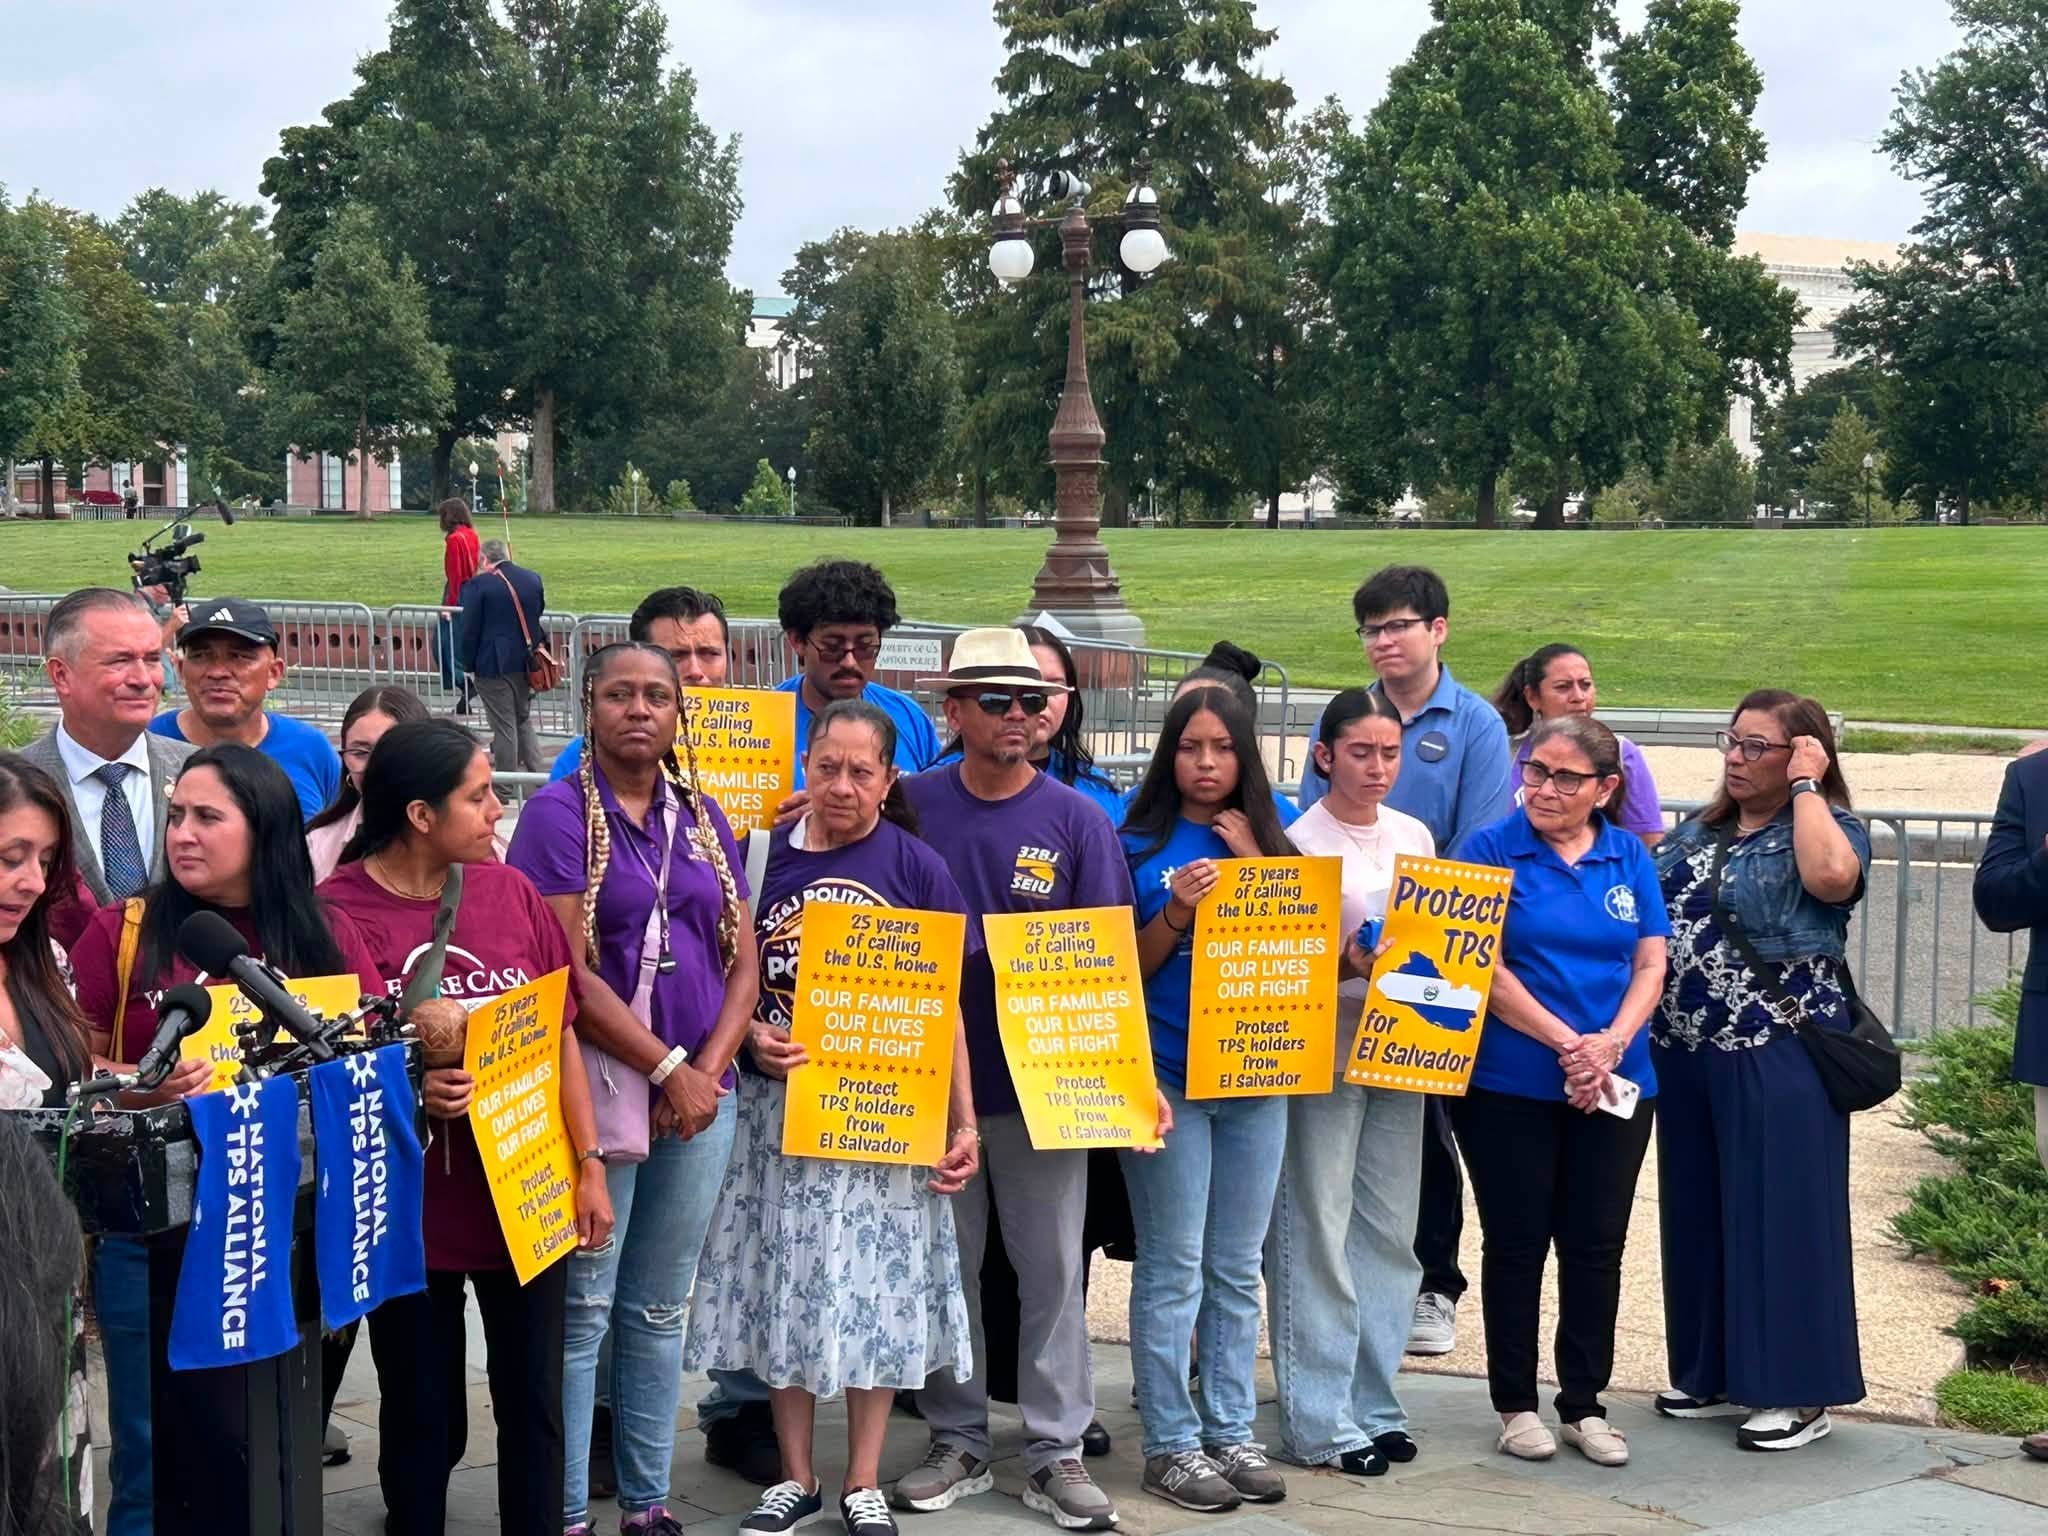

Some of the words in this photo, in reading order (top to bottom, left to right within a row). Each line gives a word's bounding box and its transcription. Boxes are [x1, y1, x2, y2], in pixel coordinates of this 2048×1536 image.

[684, 697, 702, 710] 25
[708, 699, 750, 713] years
[702, 715, 753, 733] calling
[693, 732, 722, 748] U.S.
[729, 734, 771, 749] home
[699, 771, 780, 791] FAMILIES
[1010, 877, 1054, 894] SEIU
[1239, 867, 1256, 882] 25
[1260, 866, 1300, 884] years
[1234, 884, 1252, 900] of
[1254, 883, 1302, 901] calling
[1393, 875, 1505, 925] Protect
[1217, 903, 1240, 918] the
[1245, 902, 1273, 917] U.S.
[1278, 902, 1318, 915] home
[851, 914, 871, 930] 25
[876, 917, 920, 940] years
[1025, 921, 1044, 936] 25
[1049, 920, 1090, 939] years
[846, 932, 864, 948] of
[868, 934, 921, 956] calling
[1025, 938, 1042, 954] of
[1046, 937, 1095, 953] calling
[1205, 940, 1243, 959] OUR
[1247, 937, 1327, 956] FAMILIES
[1443, 928, 1496, 969] TPS
[824, 950, 850, 967] the
[857, 952, 888, 971] U.S.
[894, 956, 938, 974] home
[1010, 957, 1034, 973] the
[1039, 957, 1069, 971] U.S.
[1073, 953, 1116, 969] home
[1220, 960, 1257, 979] OUR
[1261, 959, 1310, 977] LIVES
[466, 967, 530, 992] CASA
[1217, 982, 1255, 1000] OUR
[1259, 979, 1311, 998] FIGHT
[230, 996, 252, 1014] 25
[495, 1003, 508, 1024] 25
[509, 992, 538, 1020] years
[810, 988, 851, 1009] OUR
[857, 992, 943, 1018] FAMILIES
[1007, 996, 1045, 1014] OUR
[1048, 990, 1130, 1011] FAMILIES
[491, 1022, 504, 1045] of
[504, 1010, 538, 1038] calling
[825, 1012, 866, 1032] OUR
[872, 1016, 924, 1038] LIVES
[1025, 1016, 1063, 1035] OUR
[1067, 1012, 1117, 1033] LIVES
[1235, 1019, 1290, 1035] Protect
[1364, 1008, 1399, 1035] for
[210, 1042, 240, 1062] the
[479, 1051, 495, 1071] the
[497, 1037, 517, 1061] U.S.
[520, 1024, 548, 1048] home
[820, 1034, 862, 1054] OUR
[868, 1037, 925, 1059] FIGHT
[1027, 1036, 1065, 1055] OUR
[1069, 1032, 1121, 1053] FIGHT
[1218, 1038, 1245, 1054] TPS
[1250, 1036, 1305, 1052] holders
[1356, 1036, 1379, 1061] El
[1380, 1041, 1472, 1073] Salvador
[1243, 1054, 1279, 1071] from
[477, 1090, 503, 1120] OUR
[503, 1060, 553, 1104] FAMILIES
[838, 1076, 899, 1097] Protect
[1055, 1075, 1107, 1090] Protect
[1219, 1074, 1232, 1089] El
[1236, 1072, 1301, 1088] Salvador
[819, 1094, 848, 1113] TPS
[854, 1094, 915, 1117] holders
[1045, 1093, 1072, 1106] TPS
[1073, 1091, 1126, 1106] holders
[349, 1094, 367, 1153] TPS
[491, 1107, 517, 1138] OUR
[516, 1088, 546, 1121] LIVES
[1073, 1108, 1108, 1123] from
[497, 1132, 521, 1162] OUR
[519, 1110, 550, 1145] FIGHT
[846, 1115, 885, 1135] from
[1059, 1126, 1072, 1140] El
[1075, 1125, 1132, 1139] Salvador
[226, 1124, 248, 1187] TPS
[819, 1133, 834, 1150] El
[837, 1134, 910, 1155] Salvador
[365, 1088, 388, 1247] NATIONAL
[521, 1161, 555, 1196] Protect
[249, 1122, 266, 1292] NATIONAL
[517, 1198, 537, 1222] TPS
[536, 1176, 572, 1209] holders
[352, 1157, 371, 1304] ALLIANCE
[539, 1208, 563, 1232] from
[532, 1239, 544, 1261] El
[221, 1193, 248, 1350] ALLIANCE
